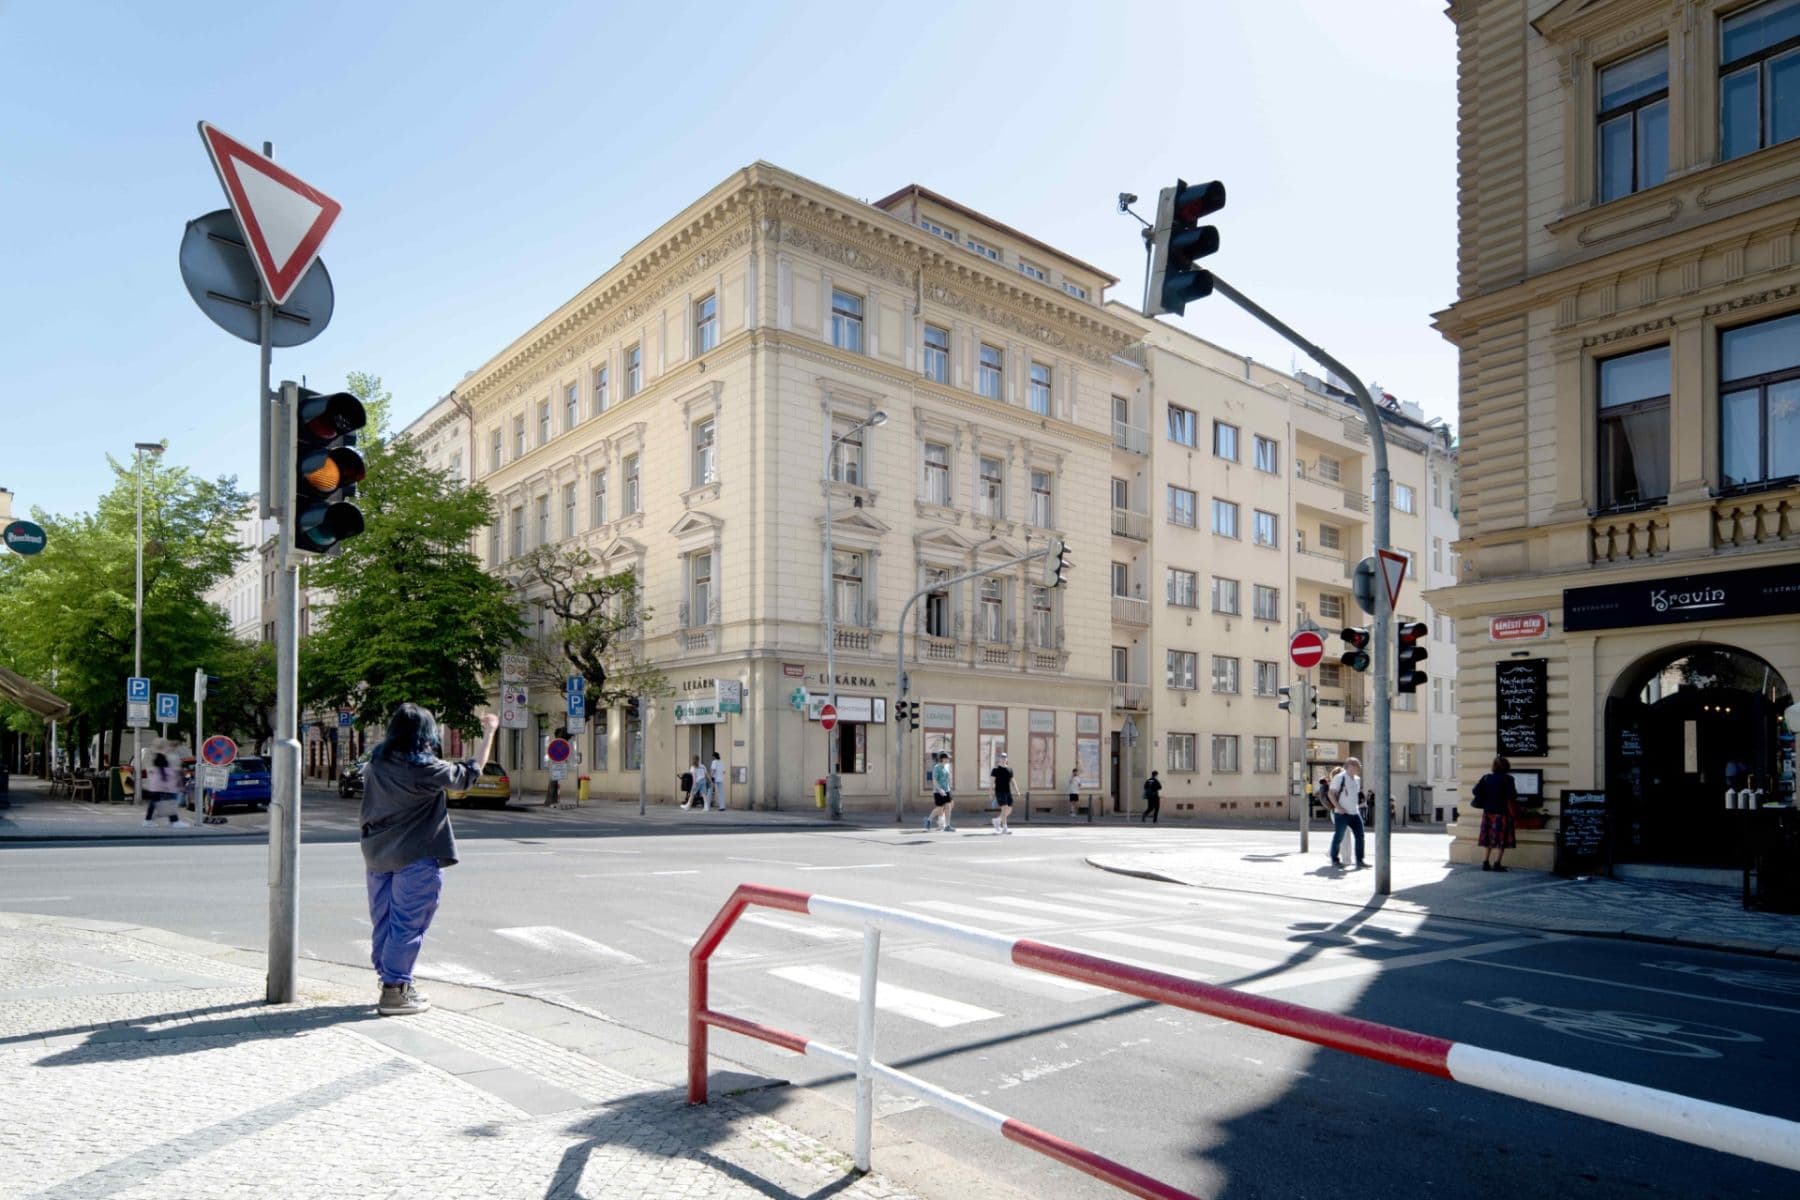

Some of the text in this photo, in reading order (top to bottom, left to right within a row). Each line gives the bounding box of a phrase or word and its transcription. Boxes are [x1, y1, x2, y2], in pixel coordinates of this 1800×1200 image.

[1650, 586, 1725, 612] Kravín
[132, 680, 145, 695] P
[162, 697, 174, 714] P
[571, 695, 581, 709] P
